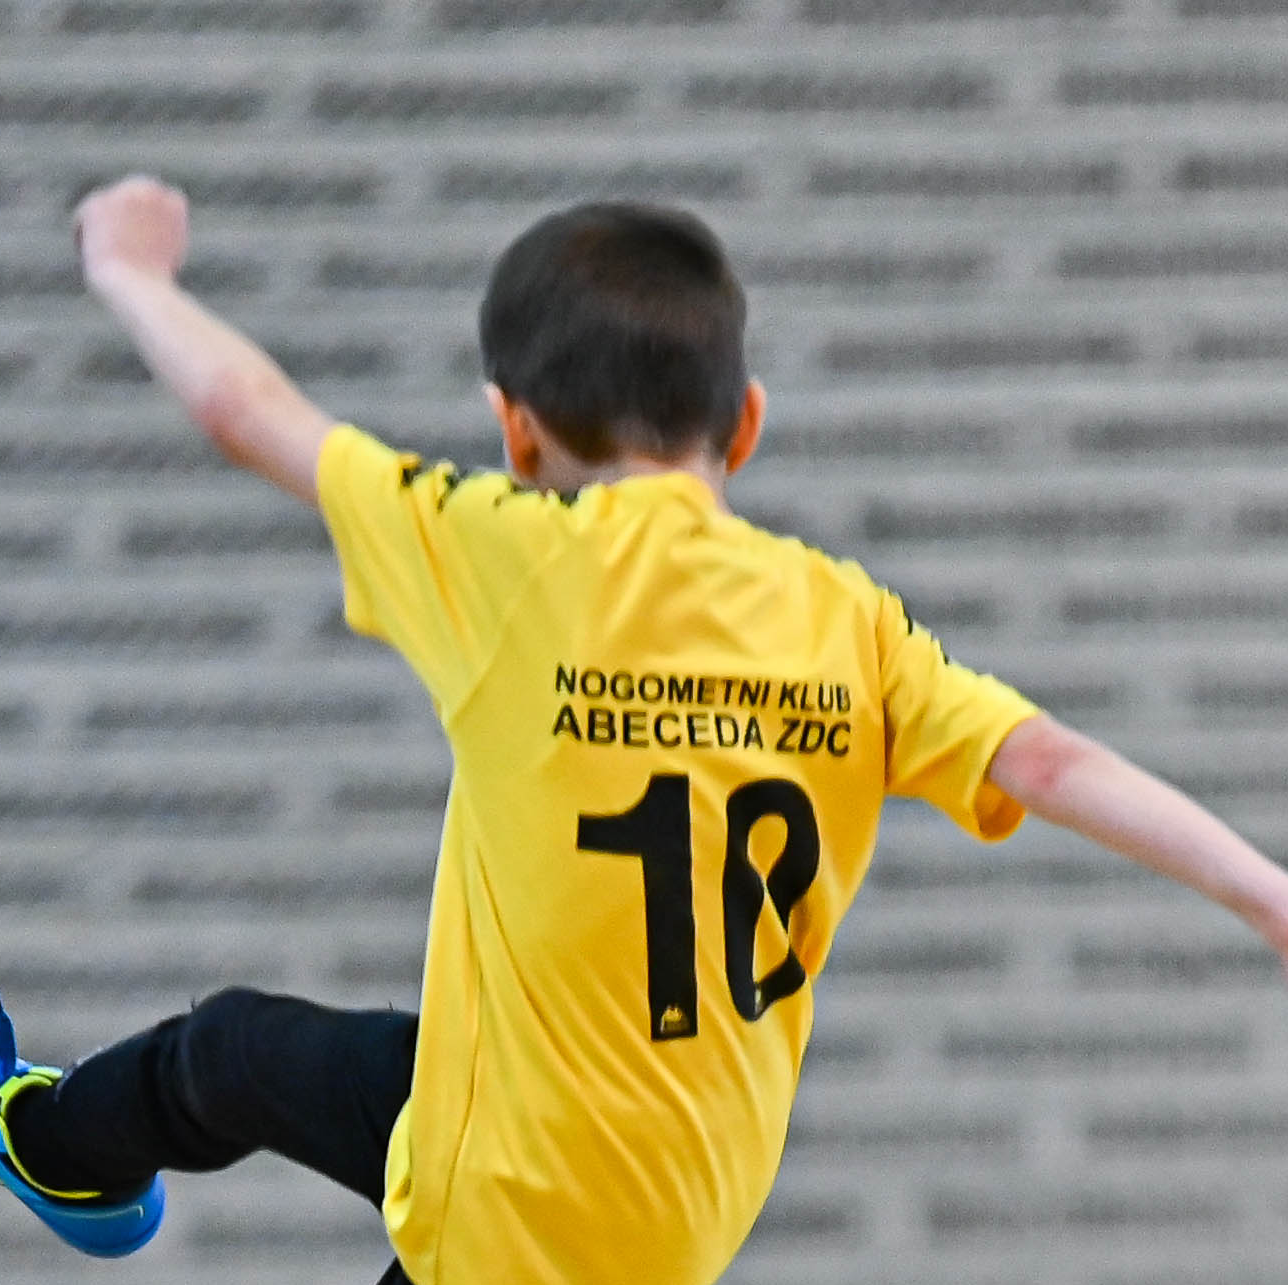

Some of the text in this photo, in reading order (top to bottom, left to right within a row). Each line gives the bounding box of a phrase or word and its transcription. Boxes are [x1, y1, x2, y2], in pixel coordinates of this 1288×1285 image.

[554, 662, 852, 713] NOGOMETNI KLUB
[552, 703, 852, 758] ABECEDA ZDC
